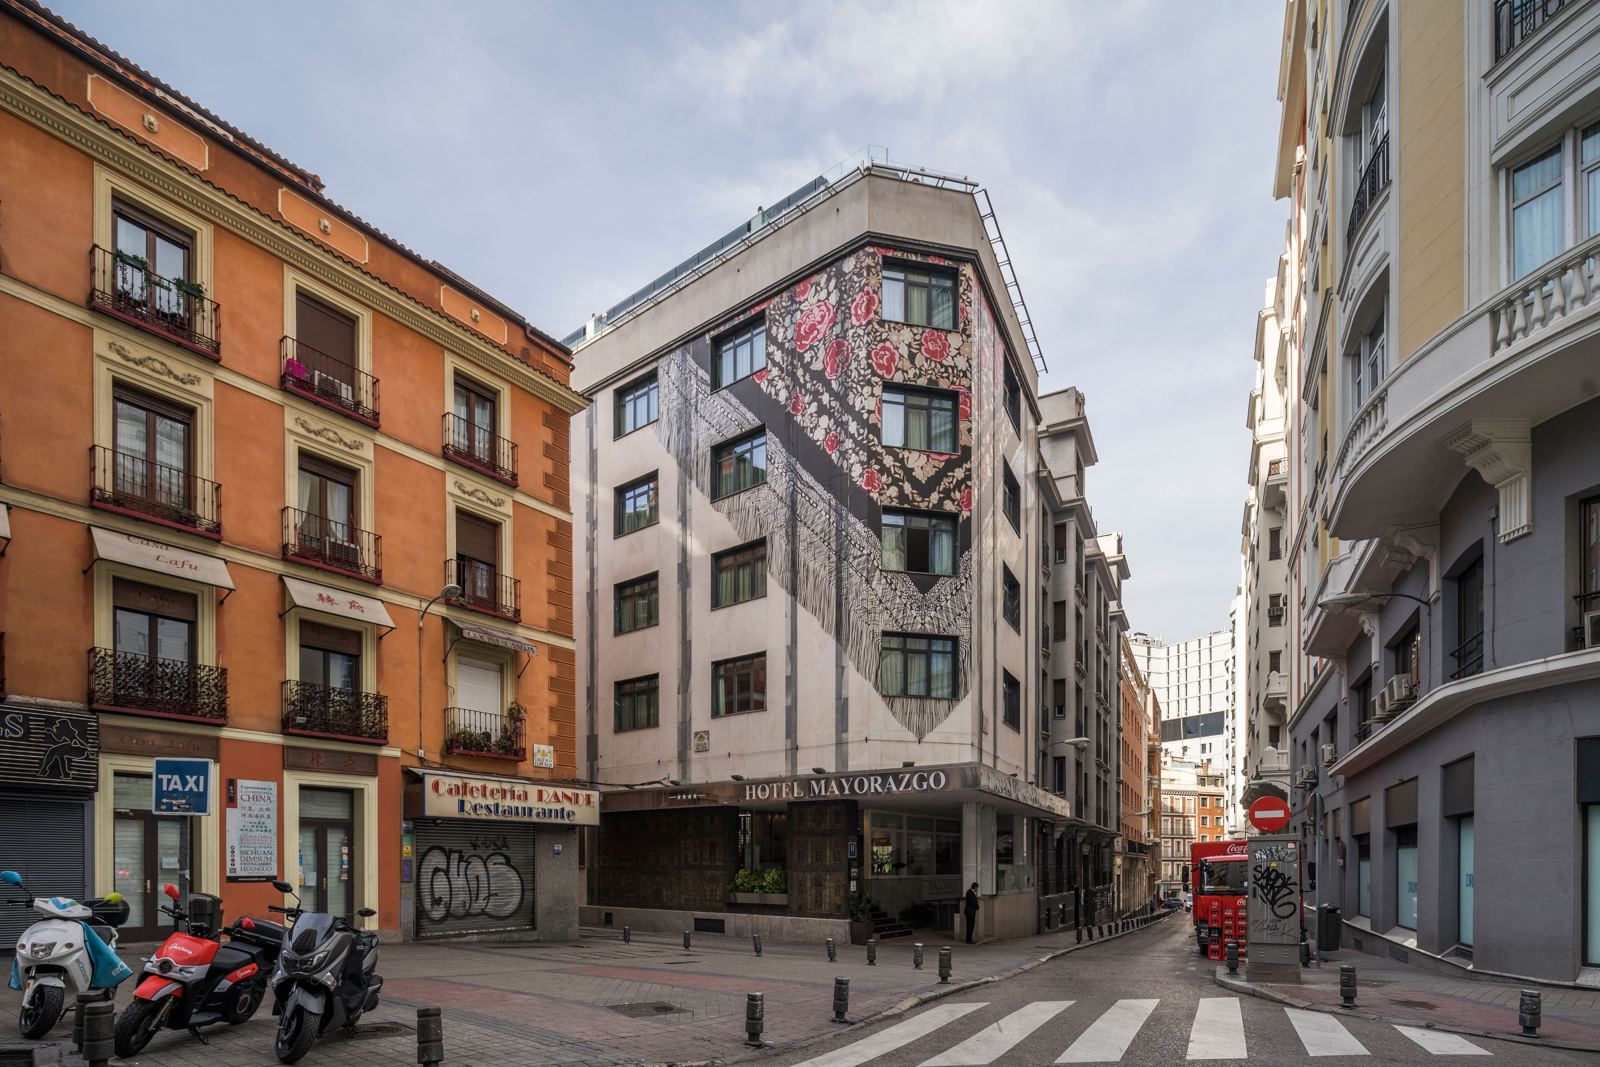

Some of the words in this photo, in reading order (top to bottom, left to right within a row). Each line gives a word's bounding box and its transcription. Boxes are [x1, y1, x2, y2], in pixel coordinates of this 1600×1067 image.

[154, 554, 199, 571] Lafu
[158, 774, 205, 792] TAXI
[745, 781, 804, 800] HOTEL
[809, 771, 947, 796] MAYORAZGO
[240, 793, 273, 803] CHINA
[457, 798, 577, 822] Restaurante
